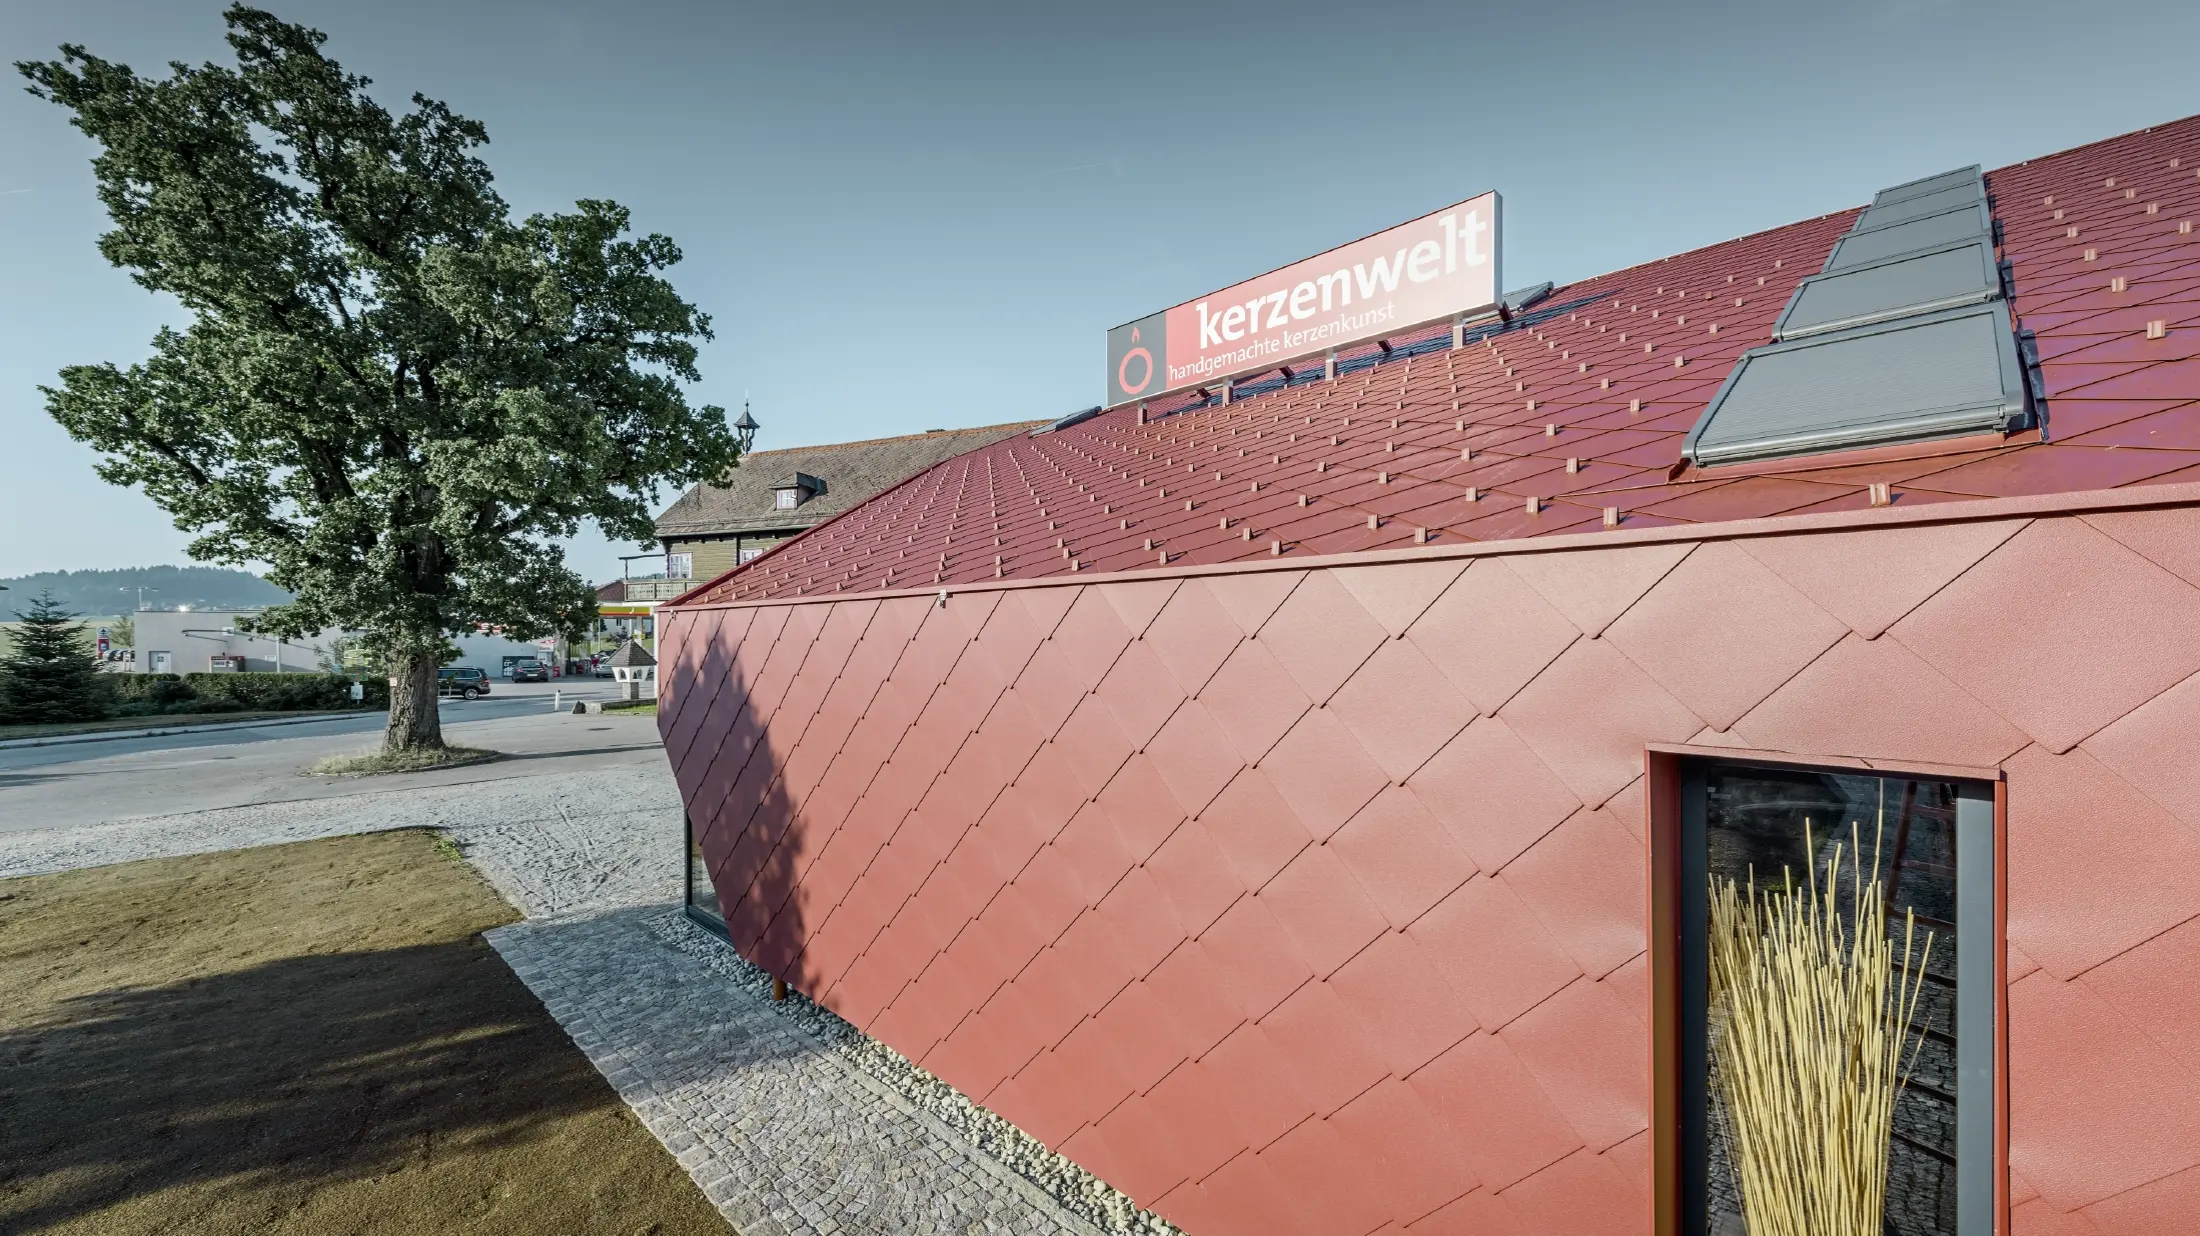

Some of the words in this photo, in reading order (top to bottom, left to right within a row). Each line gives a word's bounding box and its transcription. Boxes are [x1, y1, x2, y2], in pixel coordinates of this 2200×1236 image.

[1196, 209, 1487, 350] kerzenwelt
[1168, 338, 1280, 381] handgemachte
[1283, 301, 1396, 349] kerzenkunst
